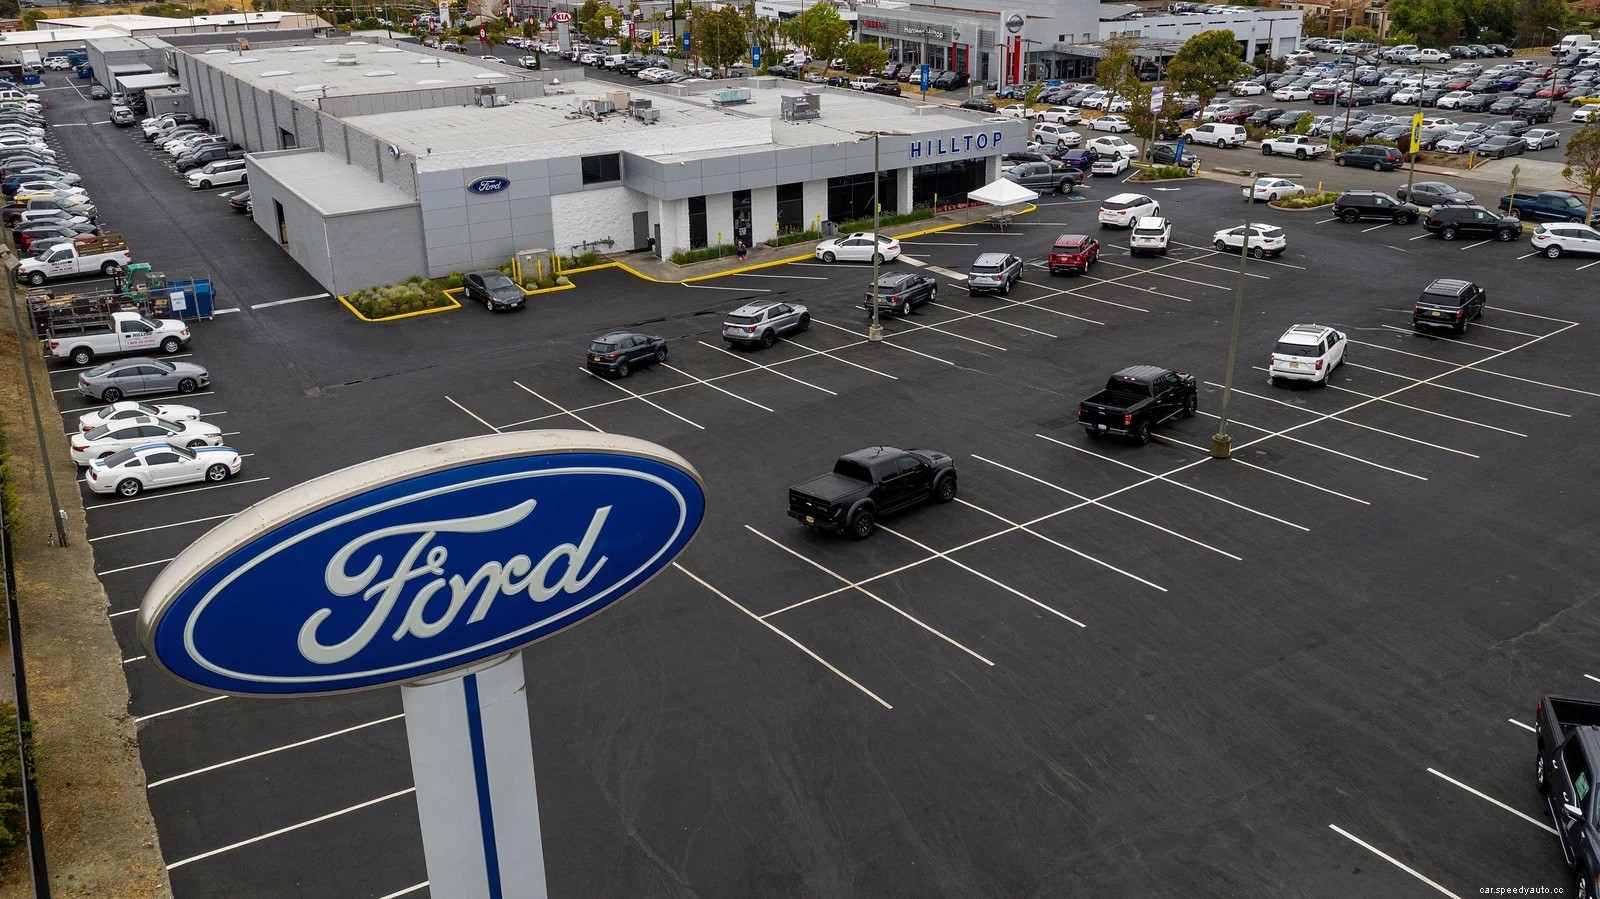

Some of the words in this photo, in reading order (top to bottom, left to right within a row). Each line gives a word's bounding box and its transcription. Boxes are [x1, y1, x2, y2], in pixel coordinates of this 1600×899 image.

[861, 19, 886, 30] NISSAN
[910, 131, 1003, 159] HILLTOP
[478, 179, 502, 191] Ford
[297, 498, 613, 665] Ford
